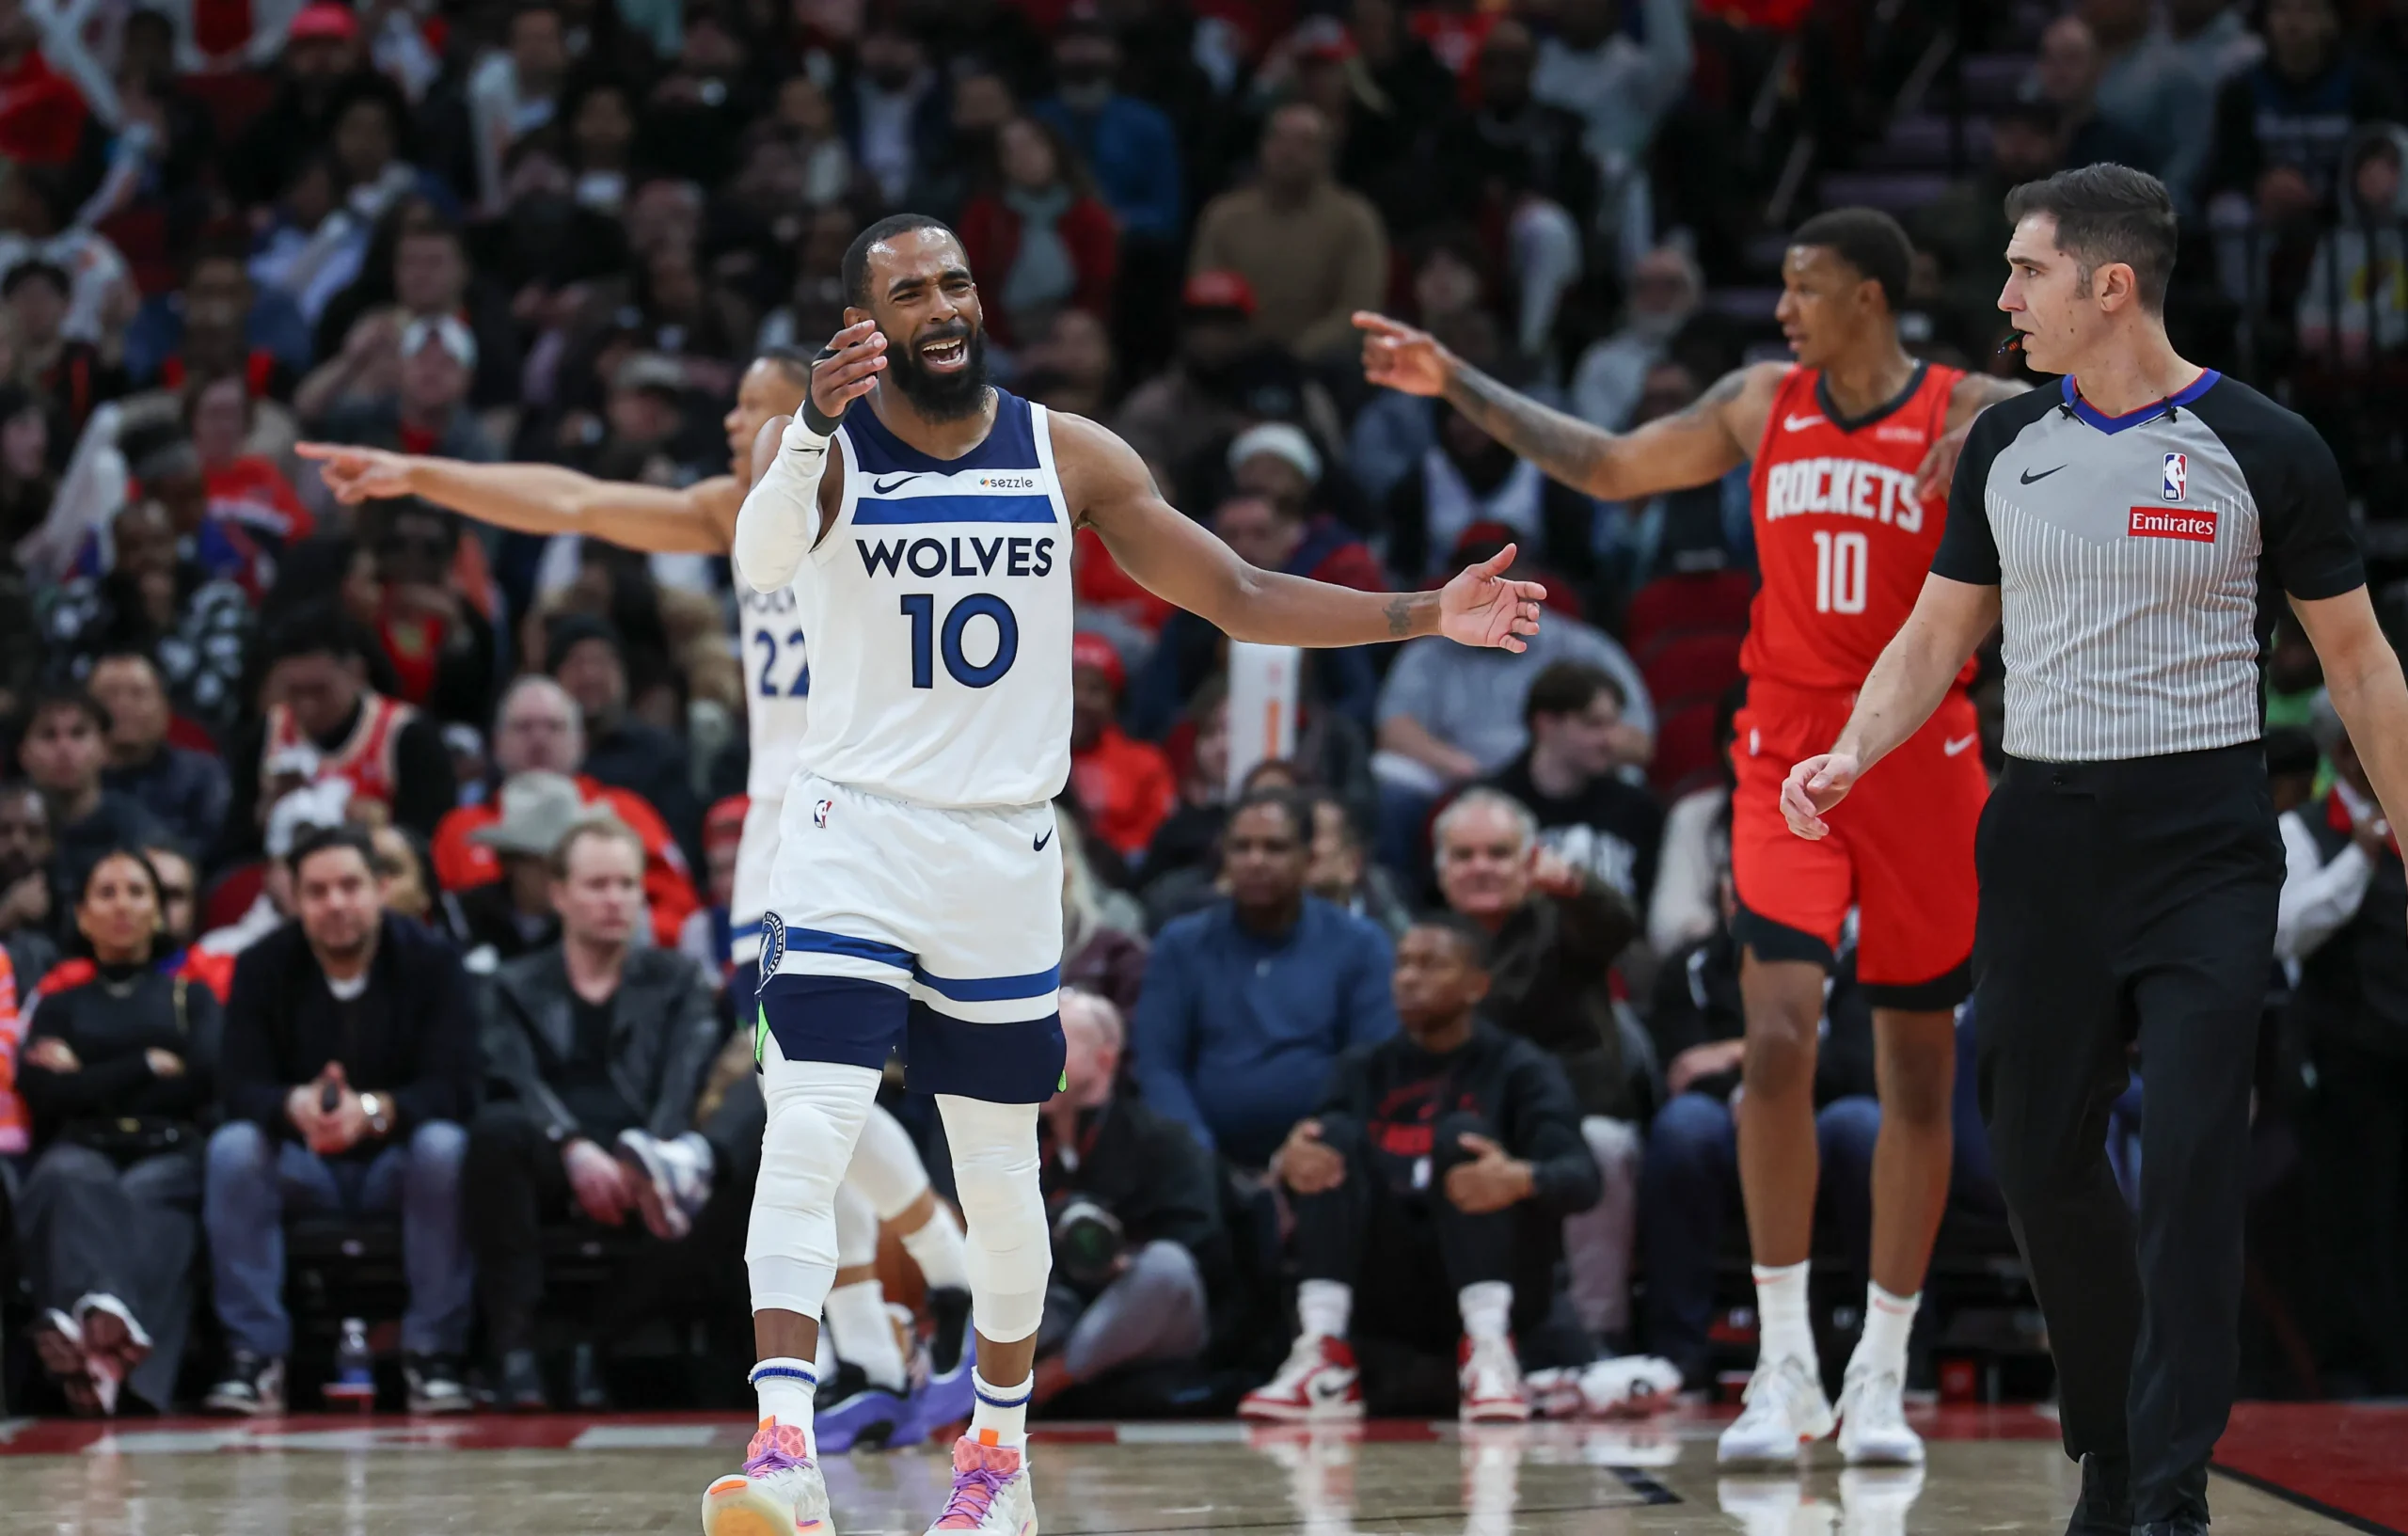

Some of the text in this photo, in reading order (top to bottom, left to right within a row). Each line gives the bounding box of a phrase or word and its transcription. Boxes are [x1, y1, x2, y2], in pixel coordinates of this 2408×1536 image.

[990, 476, 1034, 488] sezzle
[1766, 456, 1924, 534] ROCKETS
[2165, 489, 2178, 499] NBA
[2131, 513, 2214, 535] Emirates
[855, 537, 1055, 578] WOLVES
[1812, 530, 1868, 614] 10
[755, 628, 810, 697] 22
[900, 593, 1019, 689] 10
[766, 912, 783, 975] TIMBERWOLVES
